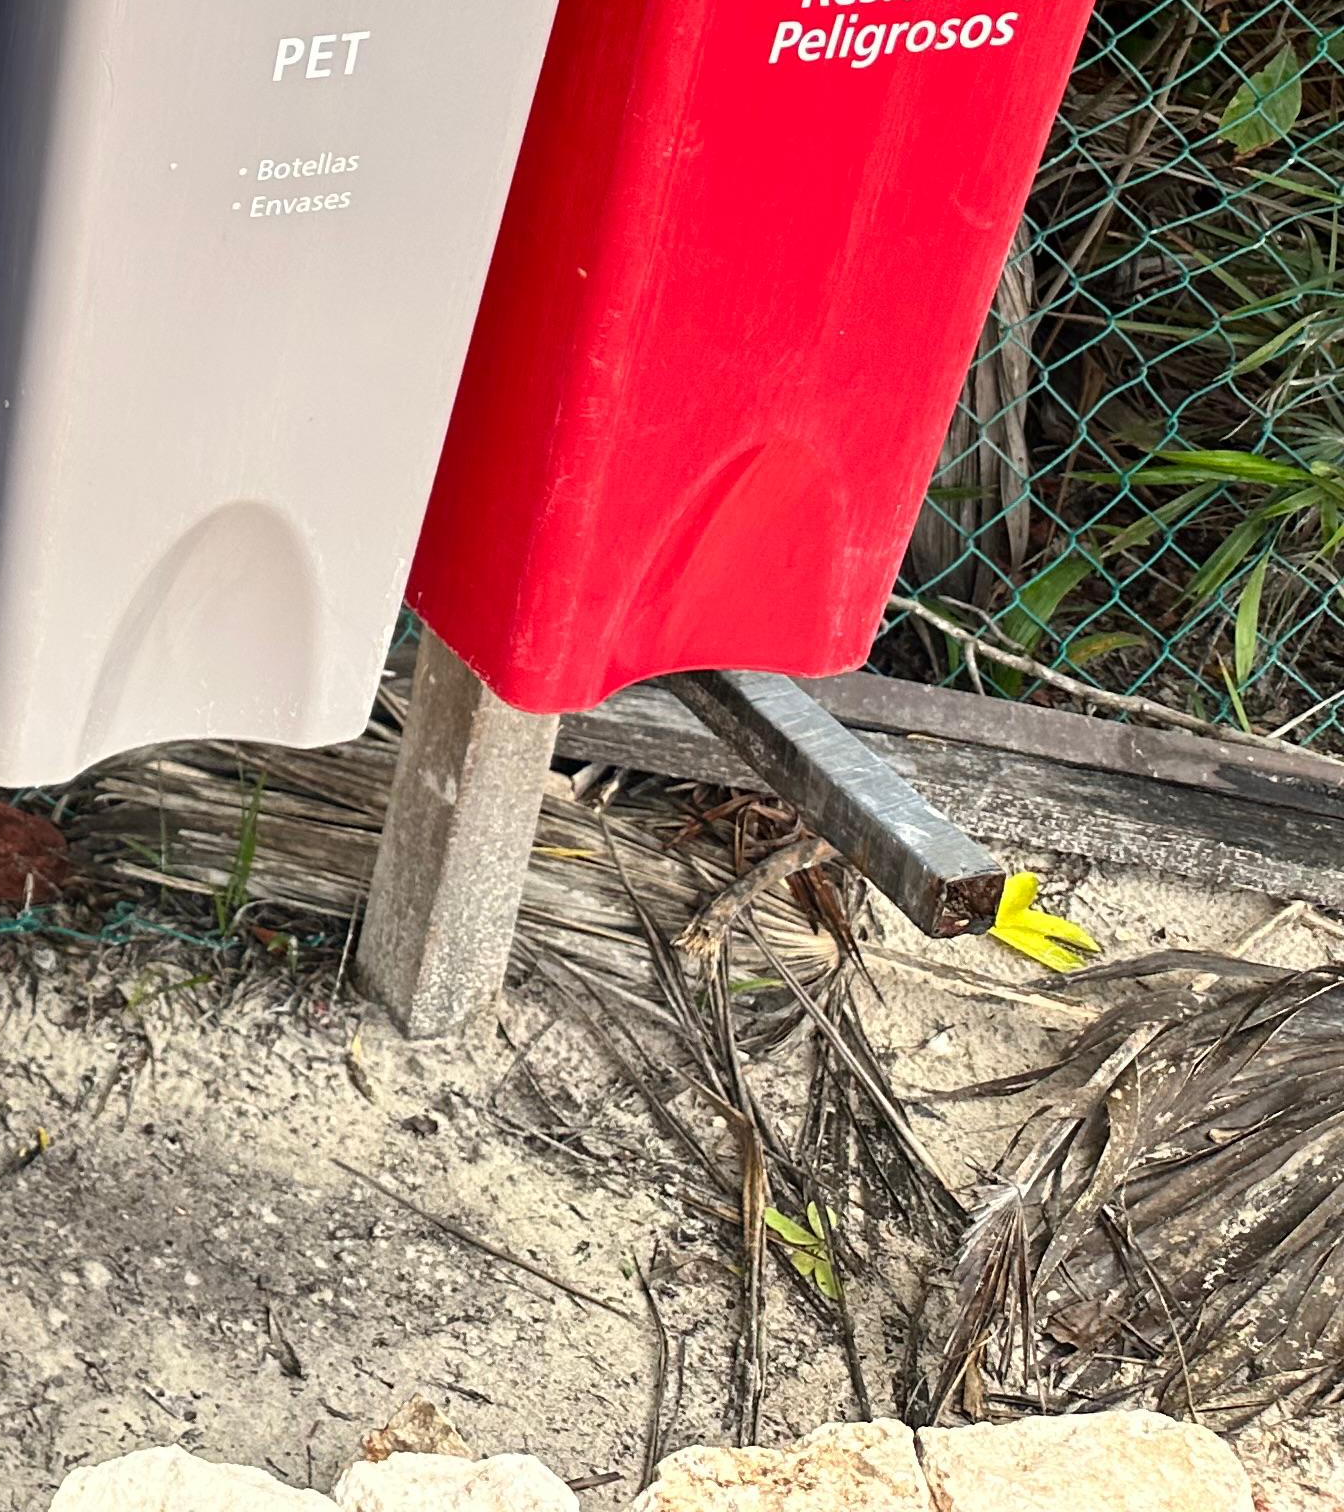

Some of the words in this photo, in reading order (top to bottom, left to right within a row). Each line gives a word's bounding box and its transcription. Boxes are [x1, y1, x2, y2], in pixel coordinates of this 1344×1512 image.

[272, 31, 371, 82] PET
[768, 11, 1019, 69] Peligrosos
[257, 152, 360, 181] Botellas
[250, 191, 352, 218] Envases
